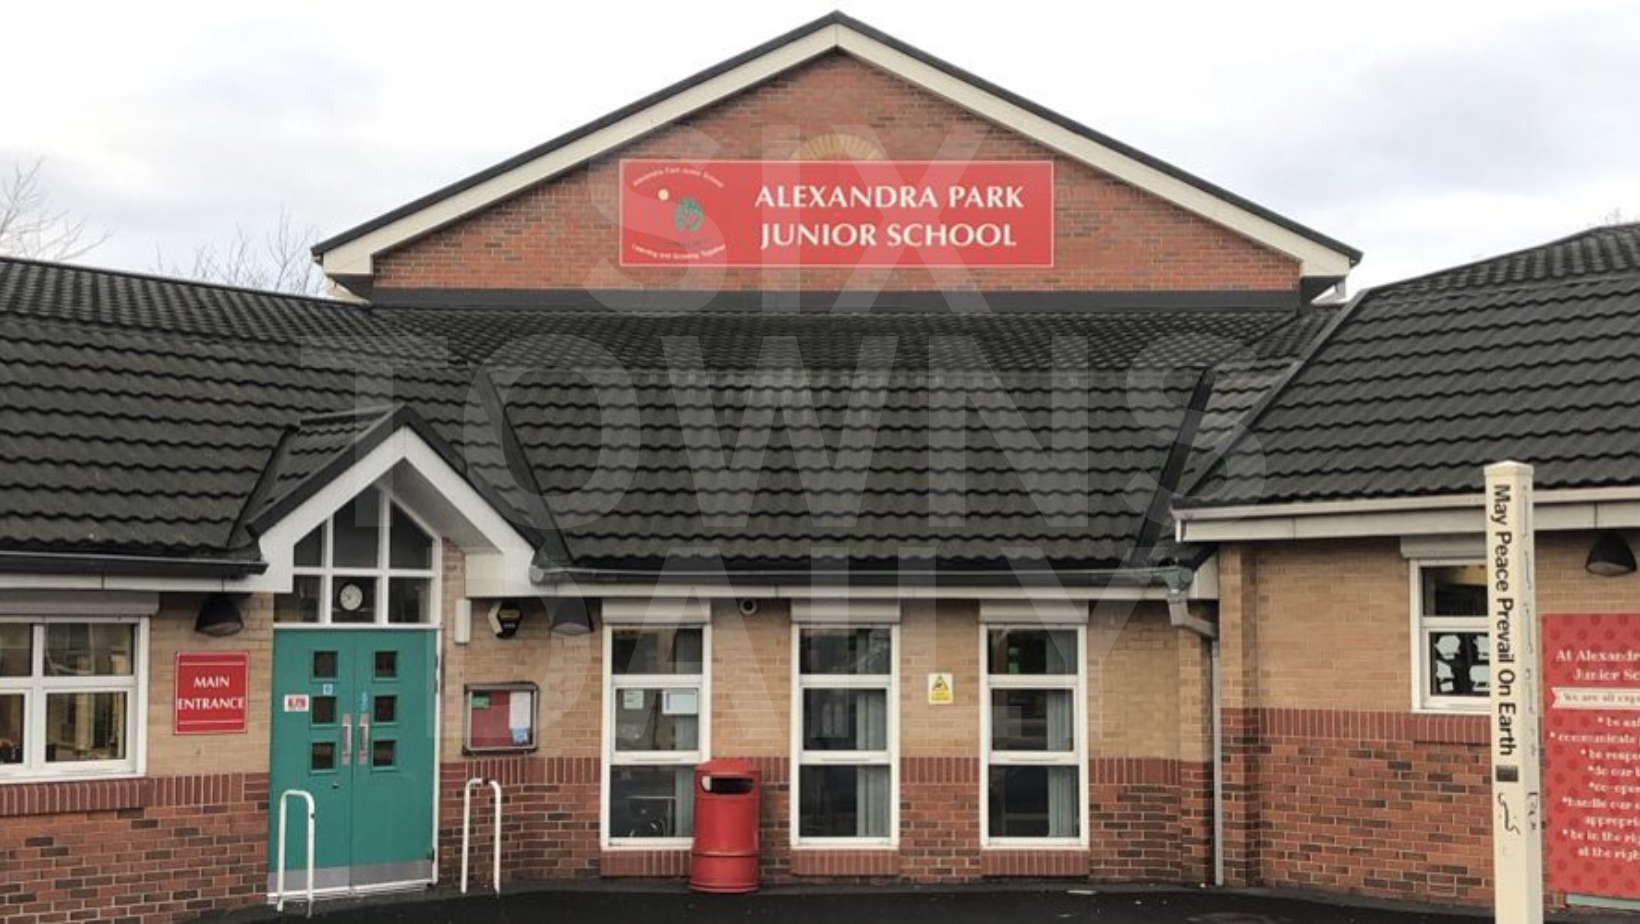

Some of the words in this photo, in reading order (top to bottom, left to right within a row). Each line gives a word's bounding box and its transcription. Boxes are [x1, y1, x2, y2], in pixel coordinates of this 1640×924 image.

[755, 185, 939, 208] ALEXANDRA
[948, 186, 1025, 208] PARK
[760, 223, 877, 250] JUNIOR
[886, 223, 1017, 247] SCHOOL
[1491, 483, 1512, 526] May
[1494, 530, 1513, 592] Peace
[1496, 597, 1516, 663] Prevail
[193, 675, 230, 688] MAIN
[1497, 667, 1517, 699] On
[178, 697, 244, 710] ENTRANCE
[1498, 702, 1518, 757] Earth
